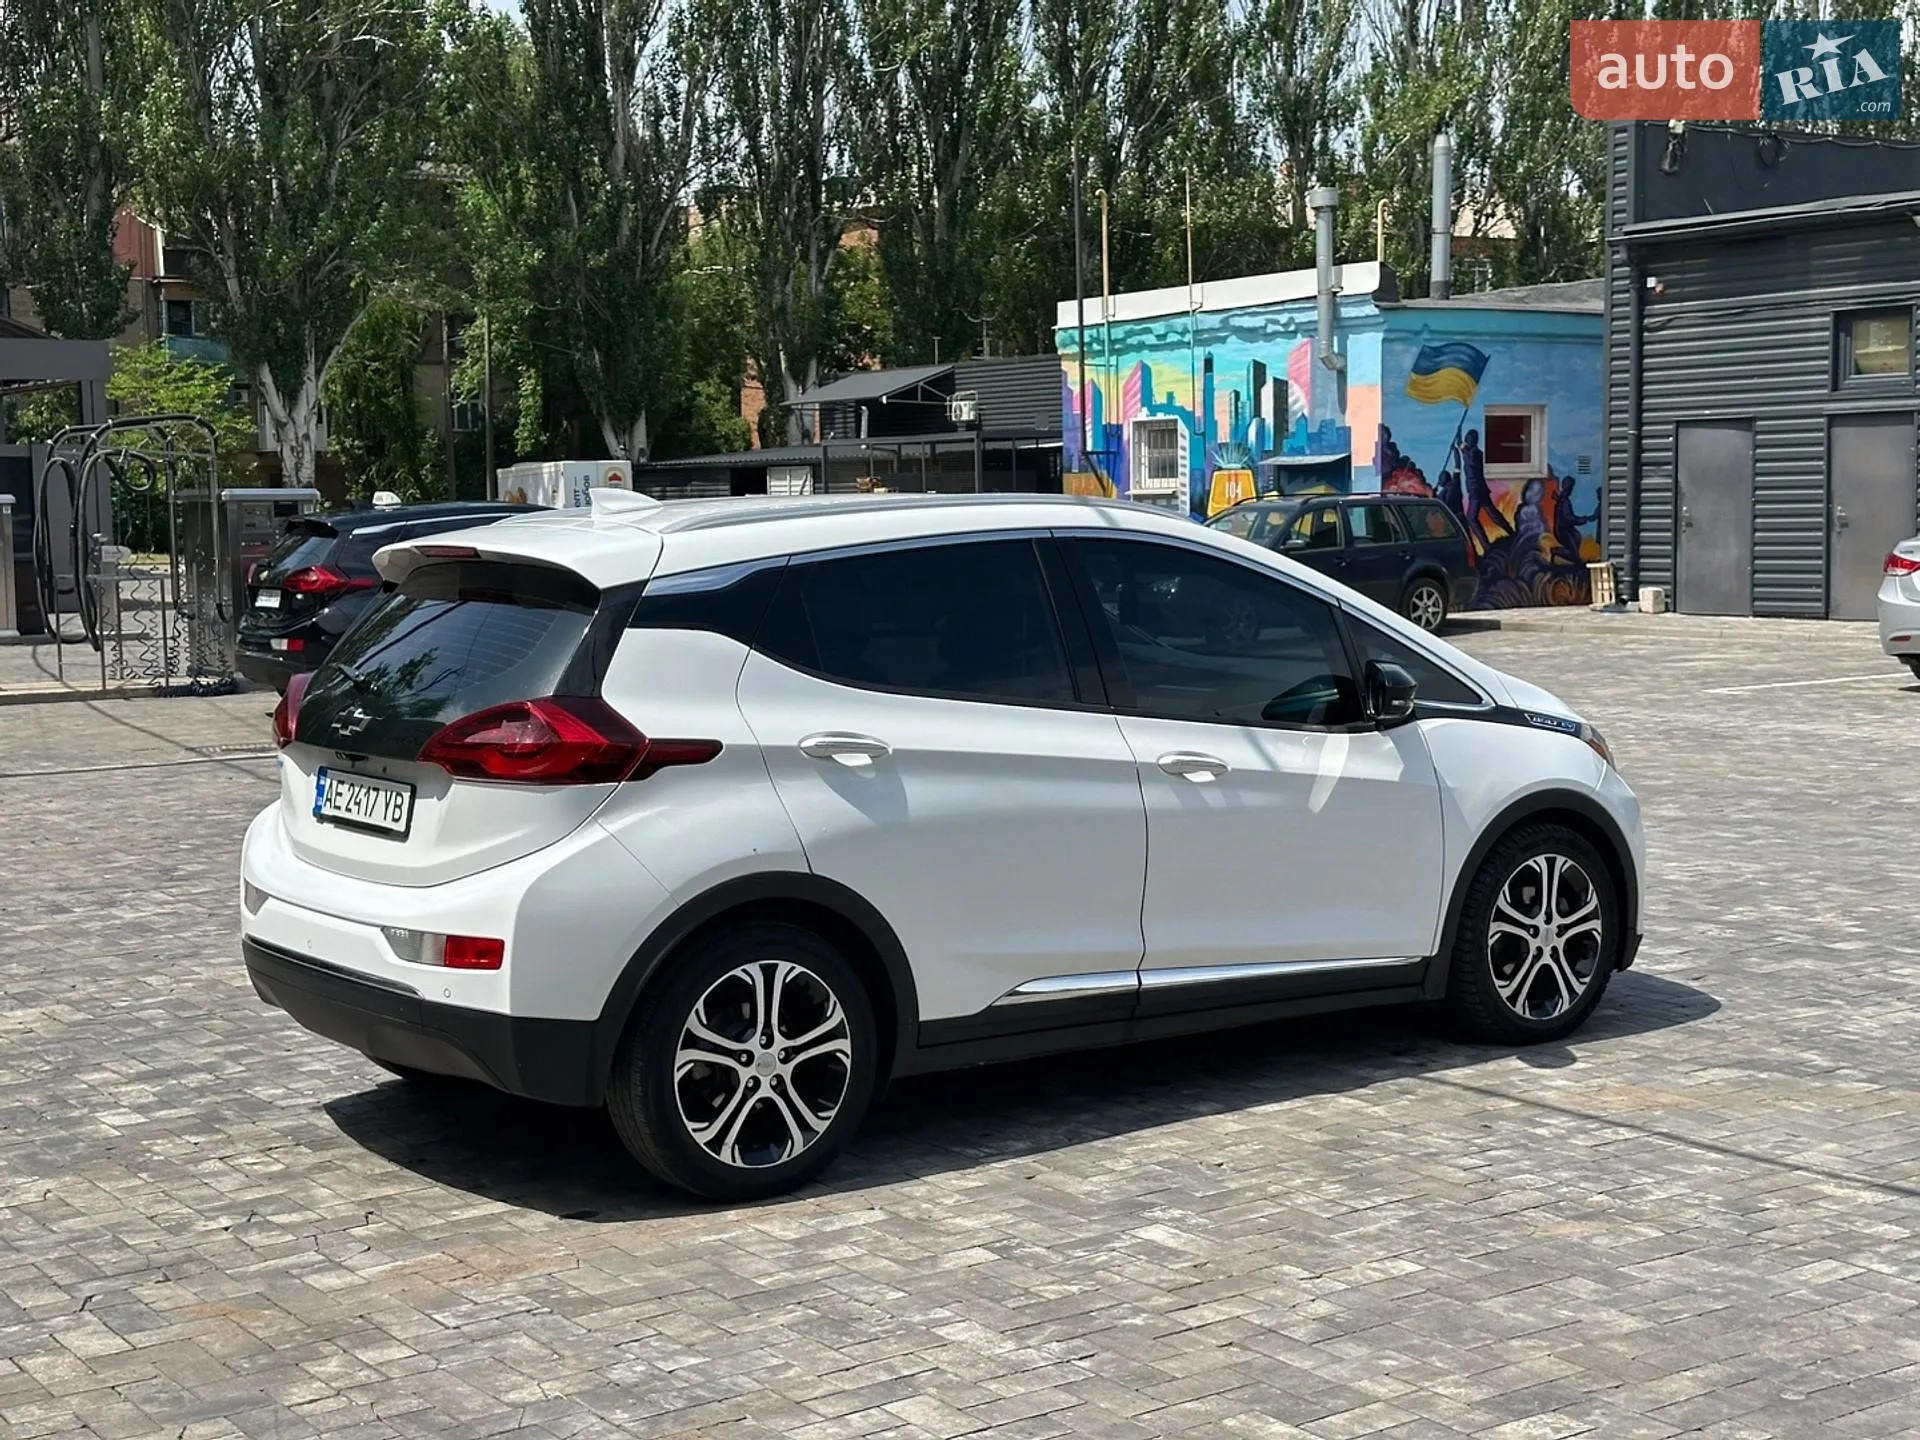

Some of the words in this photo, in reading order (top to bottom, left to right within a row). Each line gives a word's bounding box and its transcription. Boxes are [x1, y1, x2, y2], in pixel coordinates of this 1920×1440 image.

[324, 779, 345, 811] AE
[345, 782, 380, 818] 2417
[383, 789, 404, 823] YB
